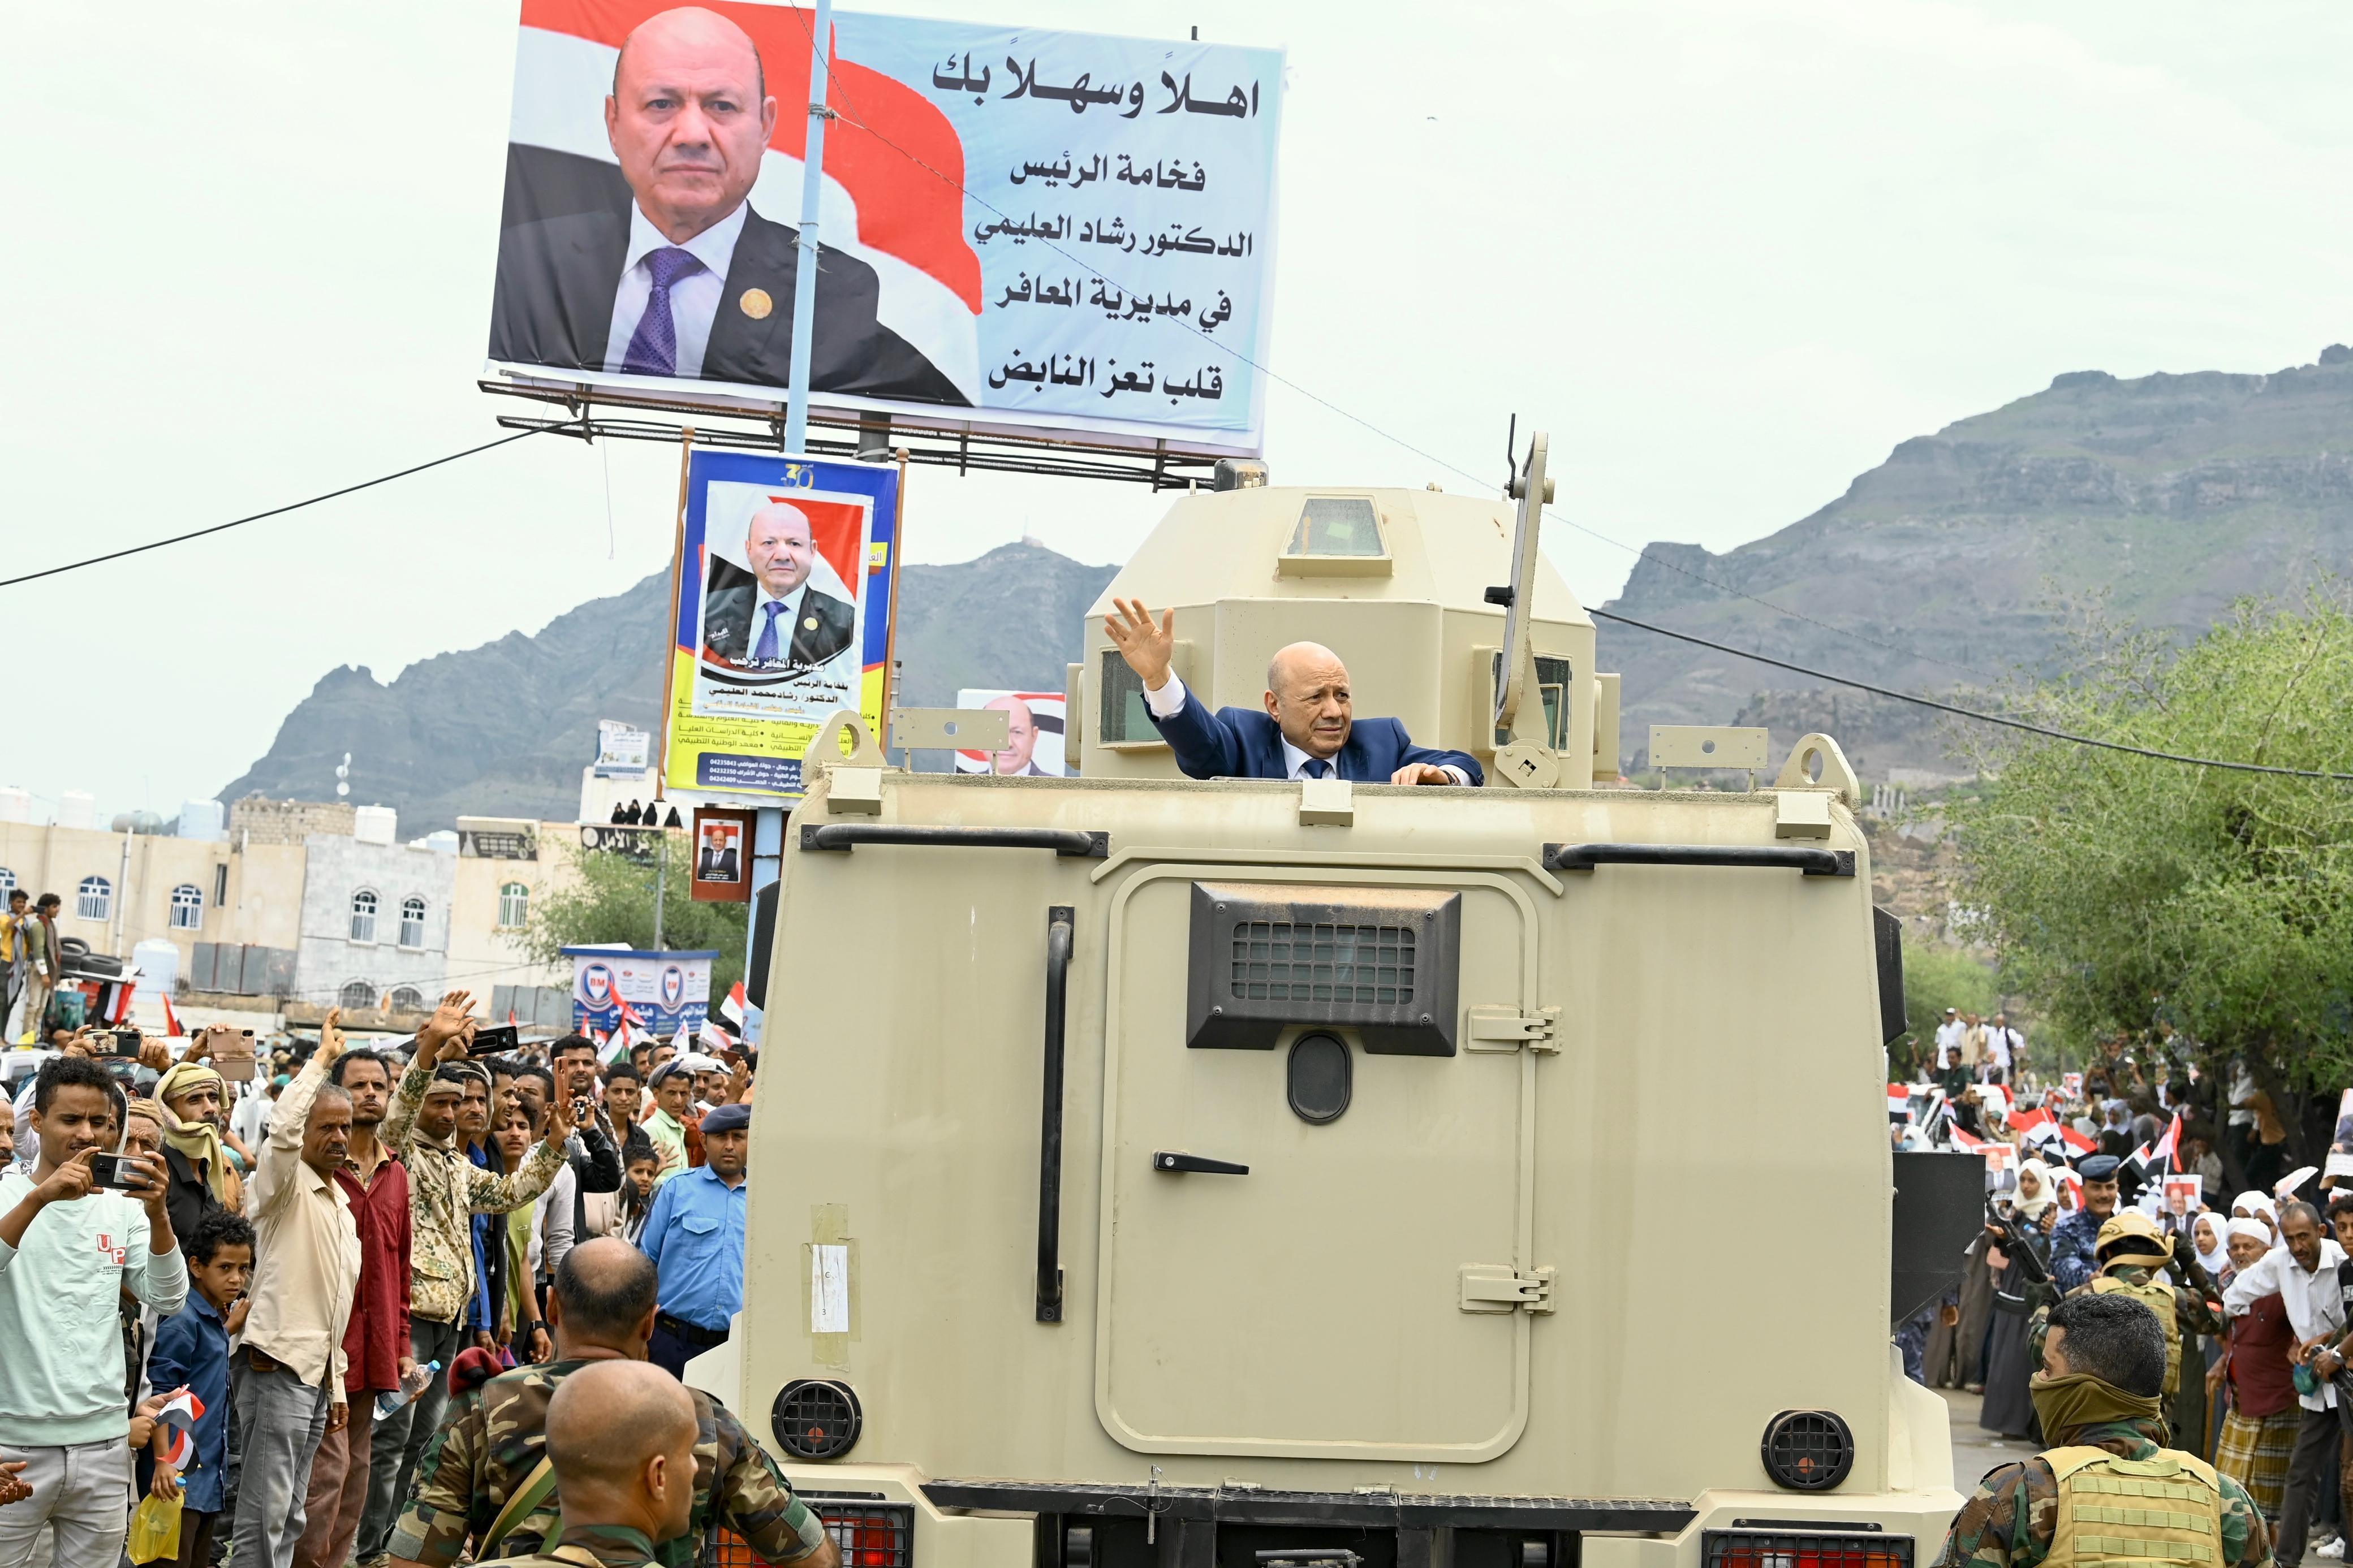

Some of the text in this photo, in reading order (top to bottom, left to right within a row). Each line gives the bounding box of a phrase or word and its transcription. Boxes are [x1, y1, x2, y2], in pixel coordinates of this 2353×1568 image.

[932, 51, 991, 107] بك
[1010, 150, 1206, 192] فخامة الرئيس
[974, 210, 1253, 258] الدكتور رشاد العليمي
[994, 271, 1232, 334] في مديرية المعافر
[988, 348, 1223, 406] قلب تعز النابض
[729, 656, 826, 673] مديرية المعافر ترحب
[793, 679, 821, 689] الرئيس
[709, 688, 748, 697] العليمي
[705, 726, 740, 736] الدراسات
